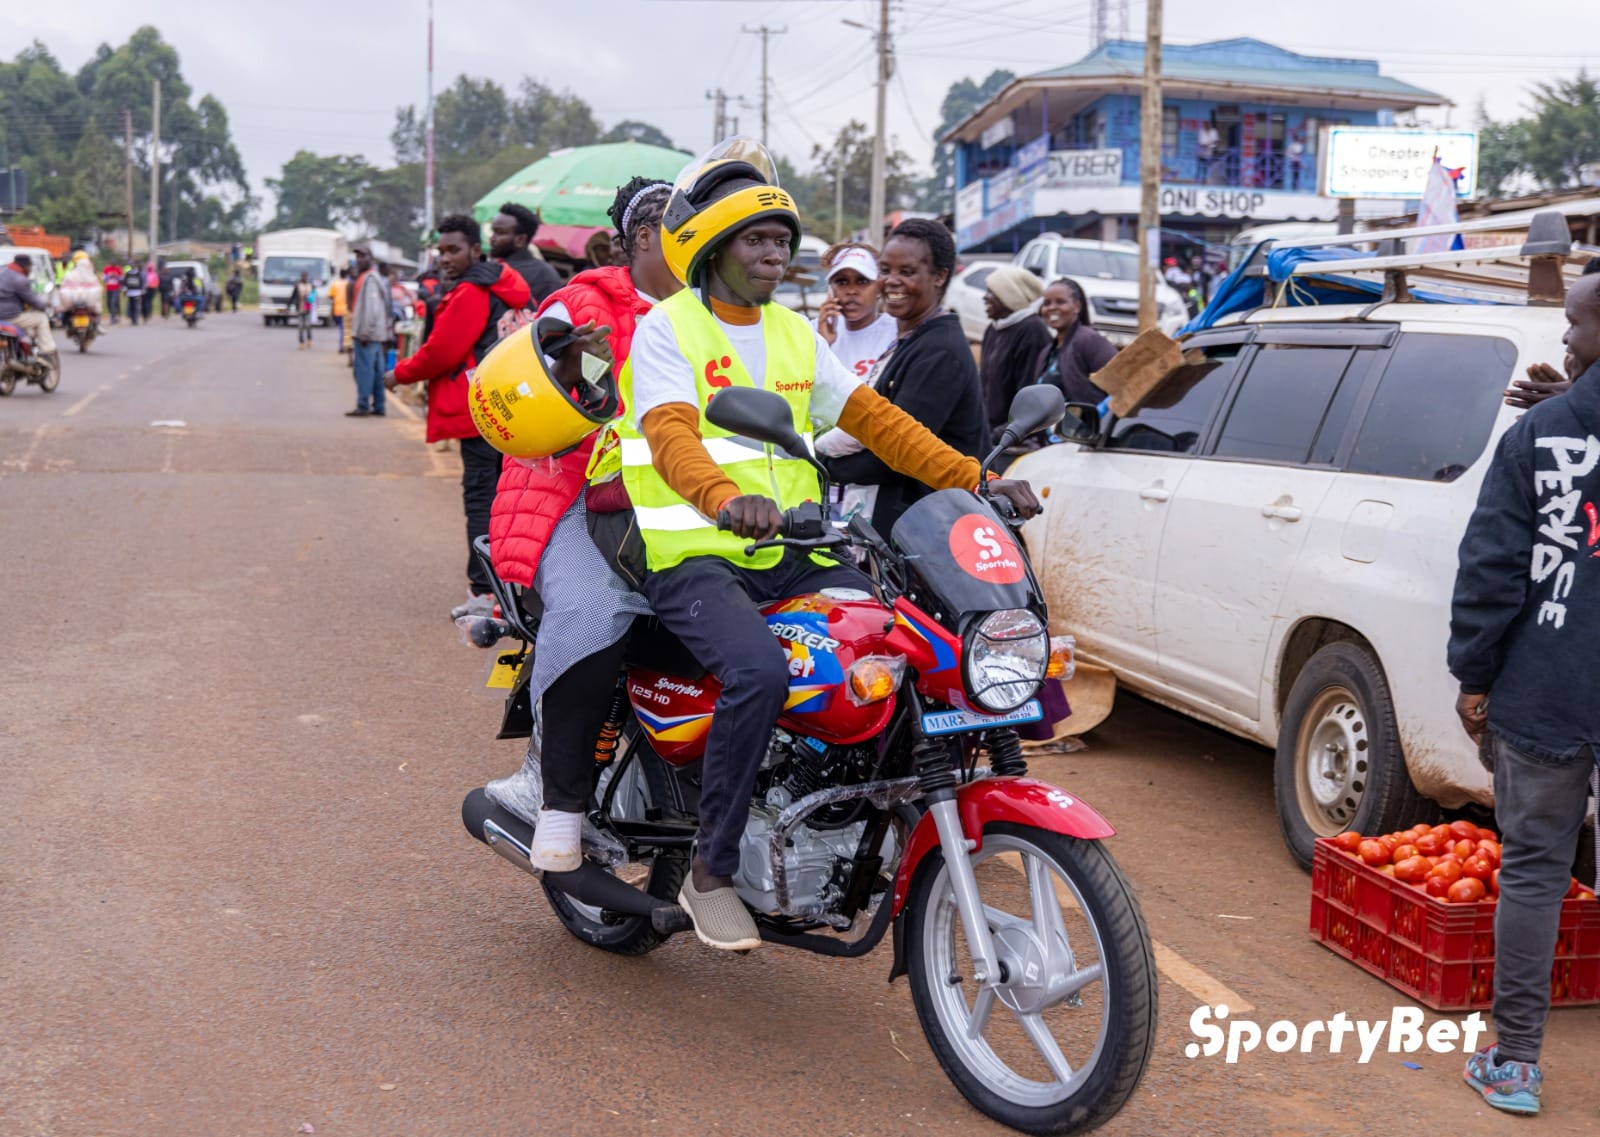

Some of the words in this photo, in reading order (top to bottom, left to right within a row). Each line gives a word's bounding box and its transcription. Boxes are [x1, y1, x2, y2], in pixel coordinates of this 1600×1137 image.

[1206, 192, 1265, 213] SHOP
[772, 622, 841, 653] BOXER
[631, 684, 653, 699] 125
[653, 692, 671, 705] HD
[654, 677, 704, 698] SportyBet
